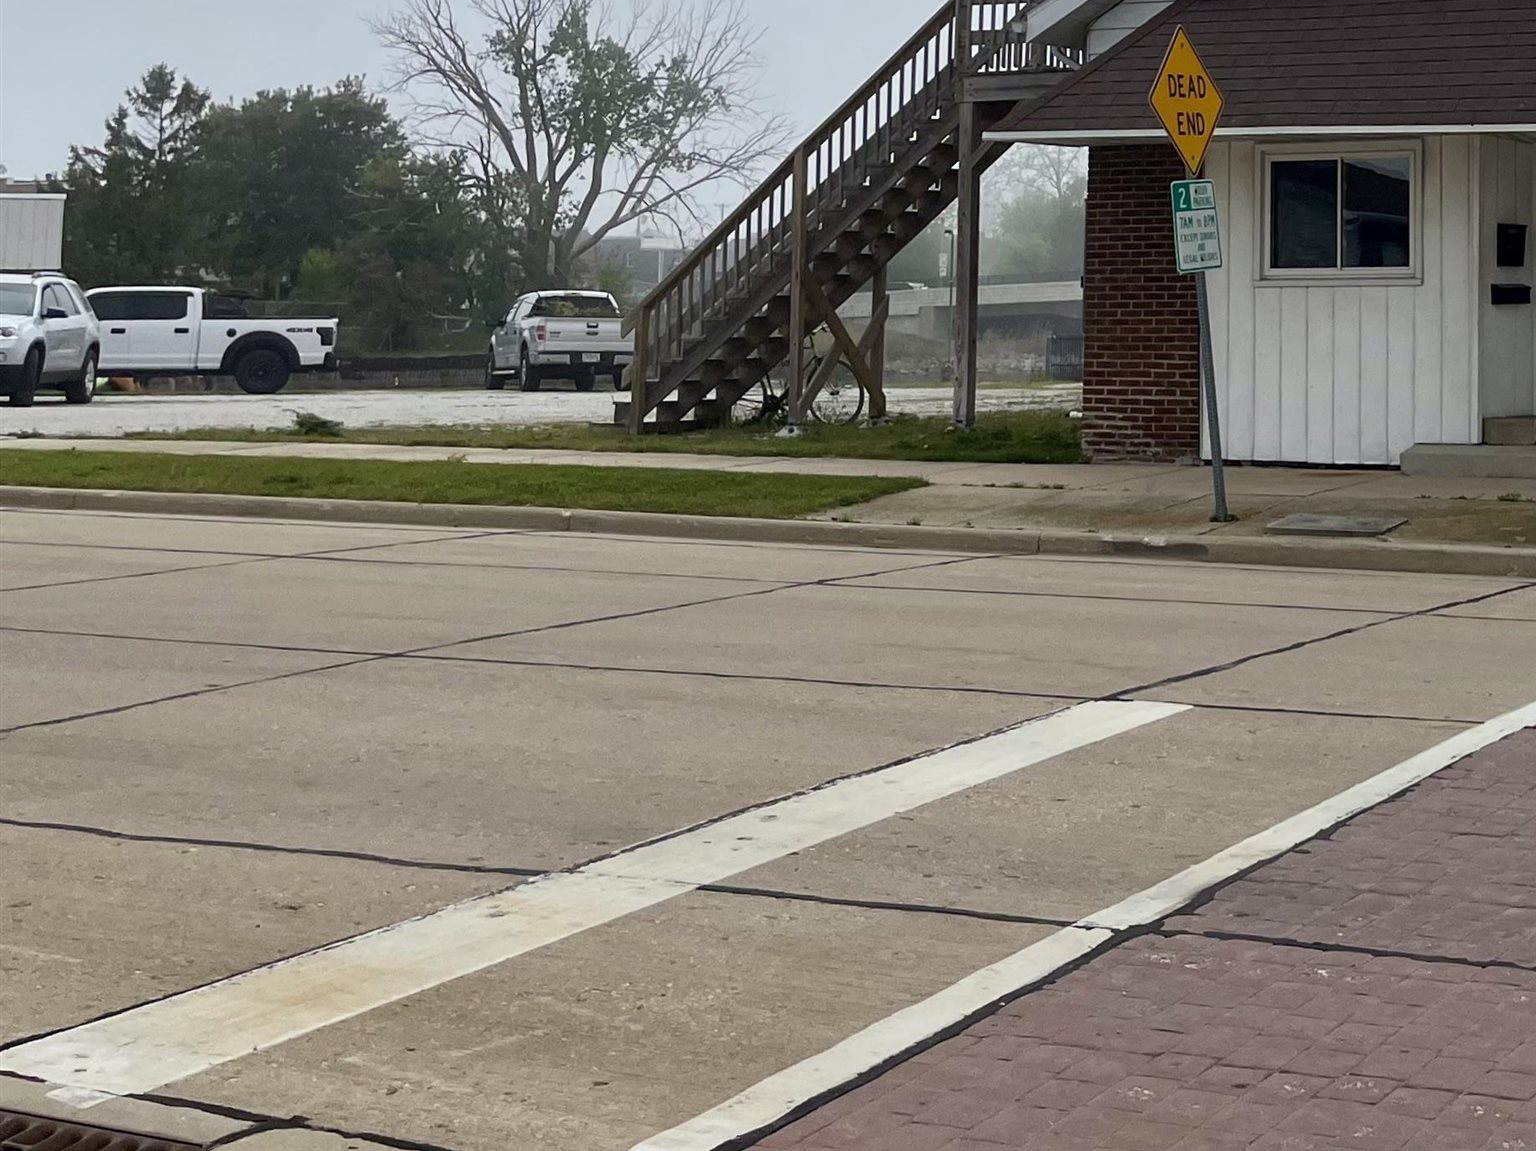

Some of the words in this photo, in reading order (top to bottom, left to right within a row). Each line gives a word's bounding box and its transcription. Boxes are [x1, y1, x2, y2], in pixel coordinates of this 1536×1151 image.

[1167, 74, 1206, 98] DEAD
[1177, 112, 1205, 136] END
[1178, 187, 1187, 208] 2
[1179, 215, 1194, 229] 7AM
